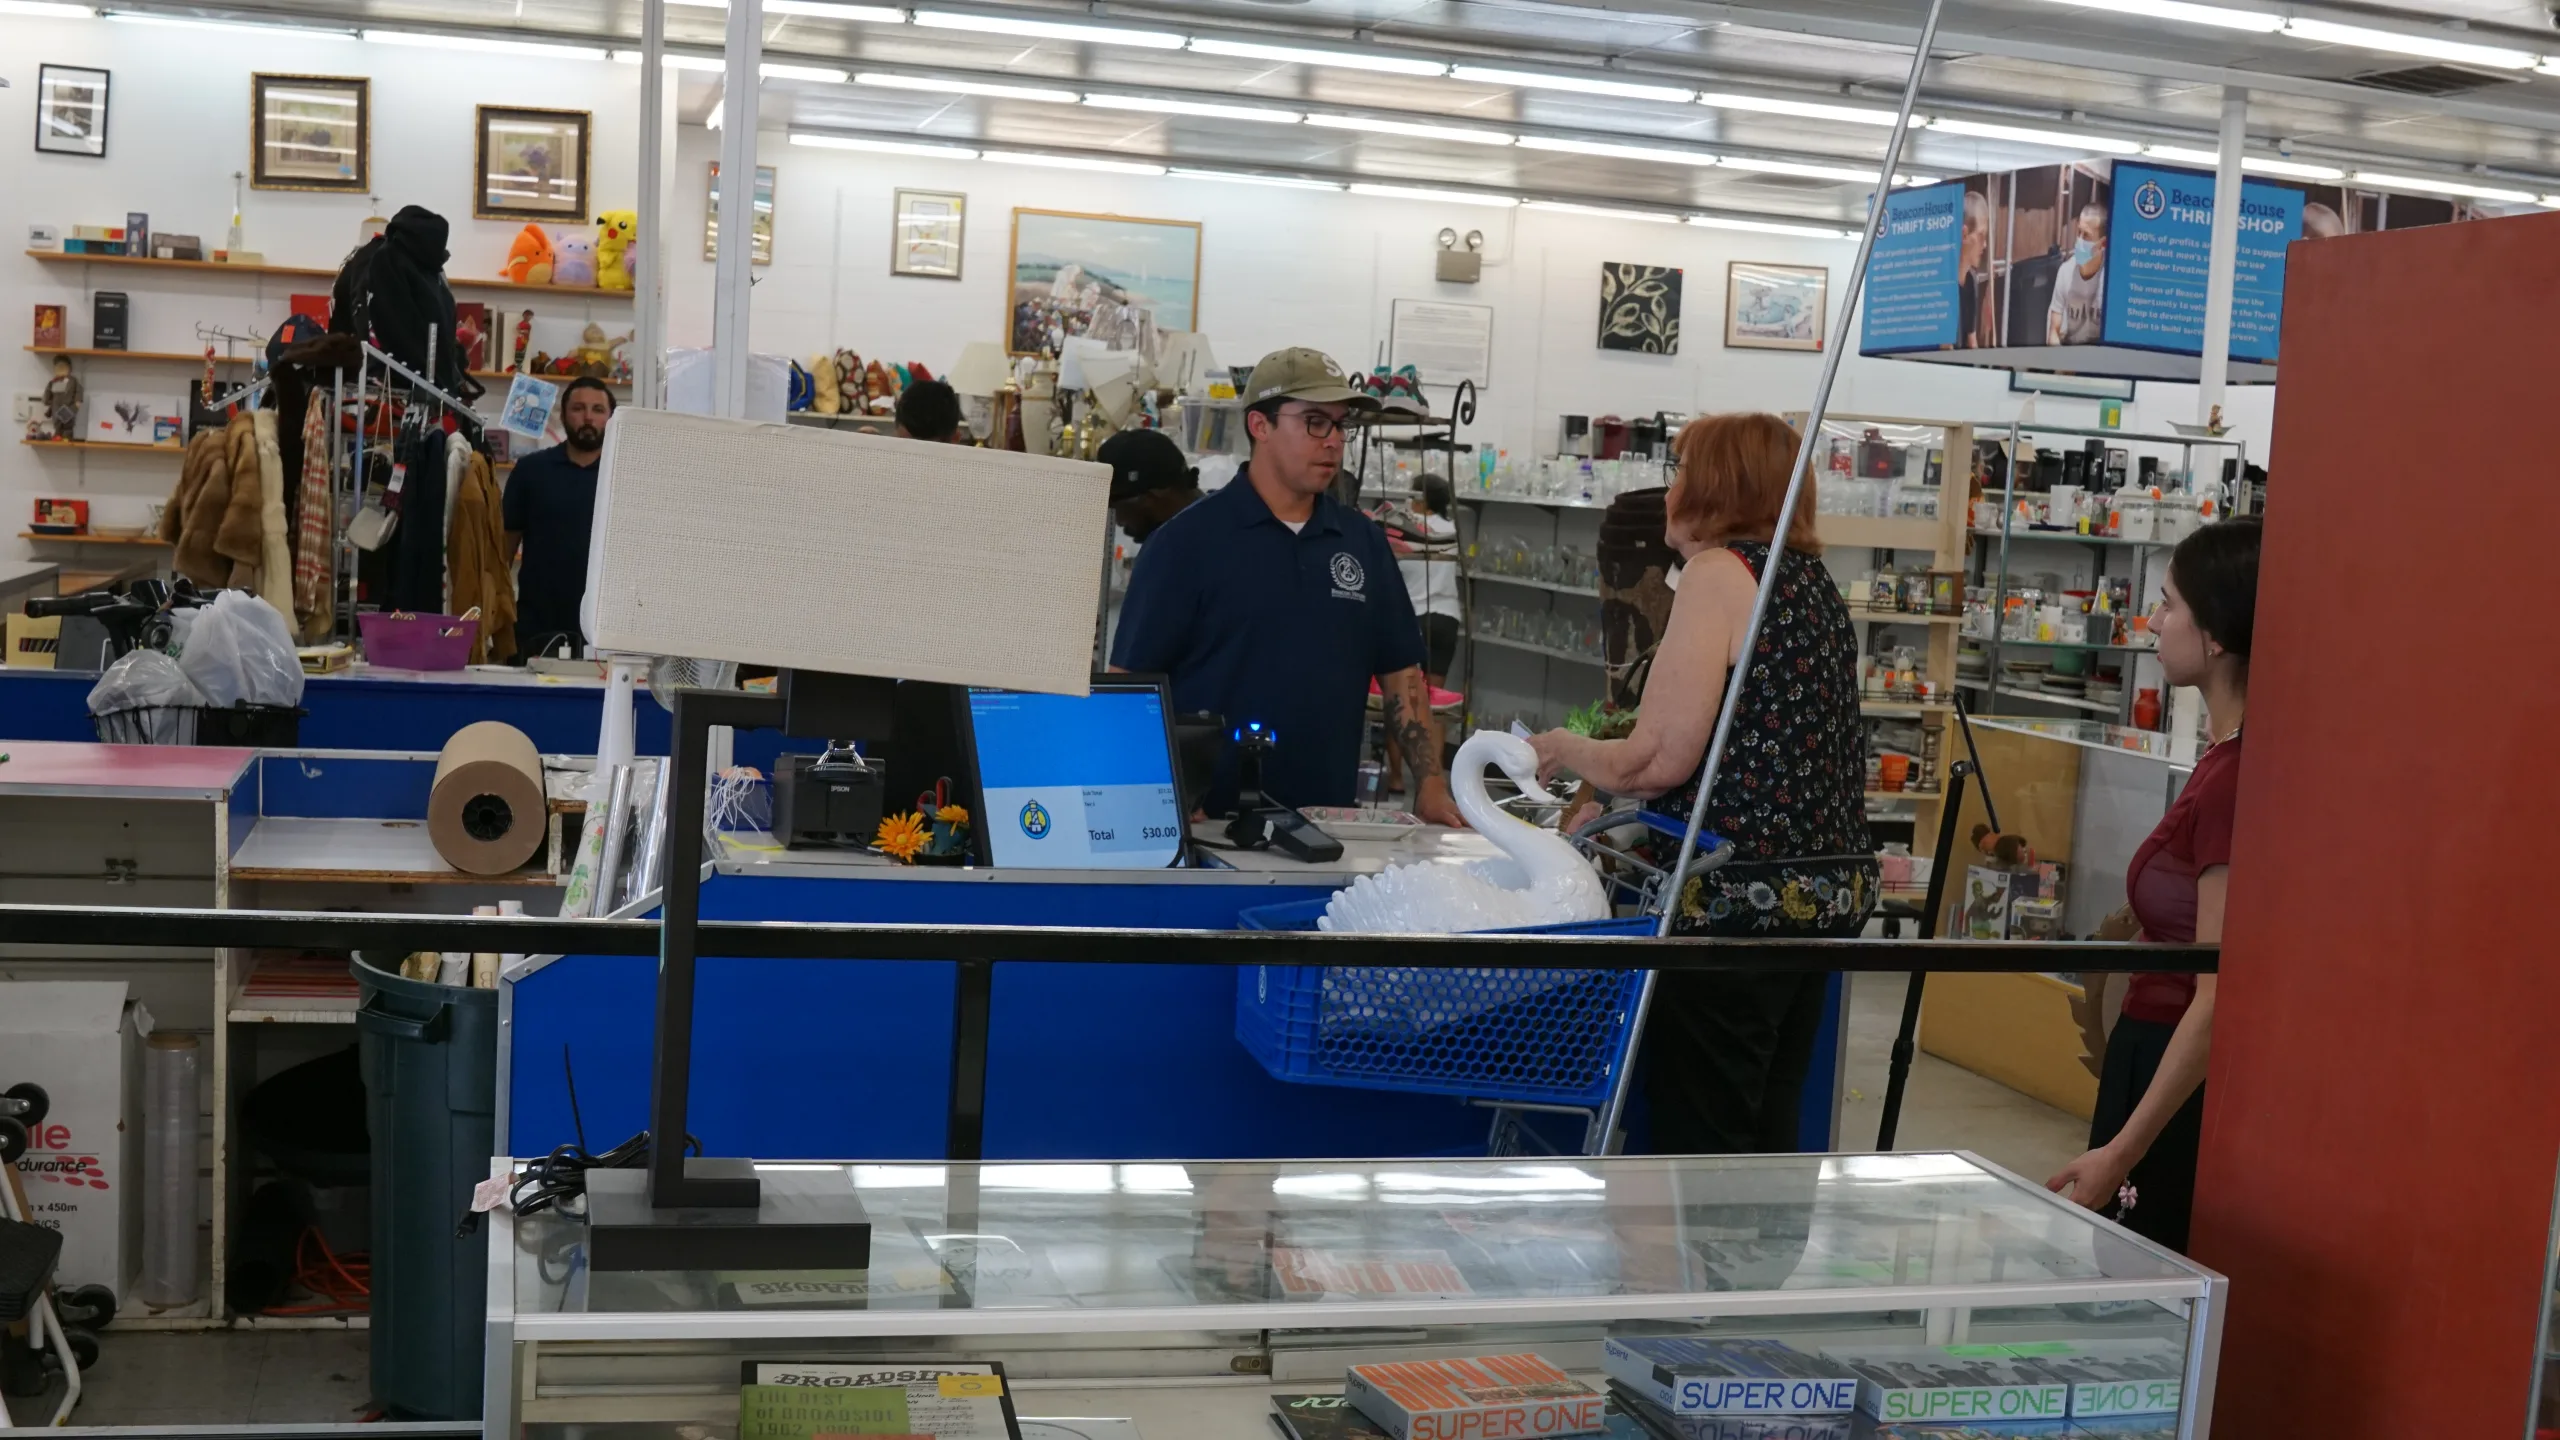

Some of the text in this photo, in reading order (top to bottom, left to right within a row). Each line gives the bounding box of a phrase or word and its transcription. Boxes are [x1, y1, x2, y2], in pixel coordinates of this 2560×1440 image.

[1892, 216, 1954, 235] THRIFT SHOP
[2238, 216, 2285, 233] SHOP
[2132, 232, 2156, 242] 100%
[2158, 235, 2168, 243] of
[2169, 238, 2200, 248] profits
[2241, 246, 2251, 254] to
[2130, 259, 2170, 271] disorder
[2131, 246, 2148, 255] our
[2150, 248, 2174, 258] adult
[2176, 251, 2201, 262] men's
[2250, 261, 2265, 270] use
[2129, 282, 2144, 292] The
[2145, 286, 2164, 295] men
[2164, 287, 2174, 296] of
[2175, 288, 2205, 299] Beacon
[2251, 298, 2265, 307] the
[2127, 307, 2148, 318] Shop
[2149, 311, 2158, 319] to
[2159, 312, 2192, 323] develop
[2128, 296, 2177, 309] opportunity
[2179, 301, 2189, 309] to
[2239, 309, 2252, 317] the
[2254, 310, 2277, 321] Thrift
[2126, 320, 2149, 330] begin
[2151, 323, 2160, 331] to
[2161, 323, 2182, 333] build
[1088, 829, 1115, 840] Total
[1142, 826, 1177, 839] $30.00
[48, 1203, 78, 1212] 450m
[1681, 1382, 1854, 1409] SUPER ONE
[1885, 1387, 2065, 1418] SUPER ONE
[756, 1408, 895, 1422] of BROADSIDE
[1413, 1401, 1602, 1440] SUPER ONE
